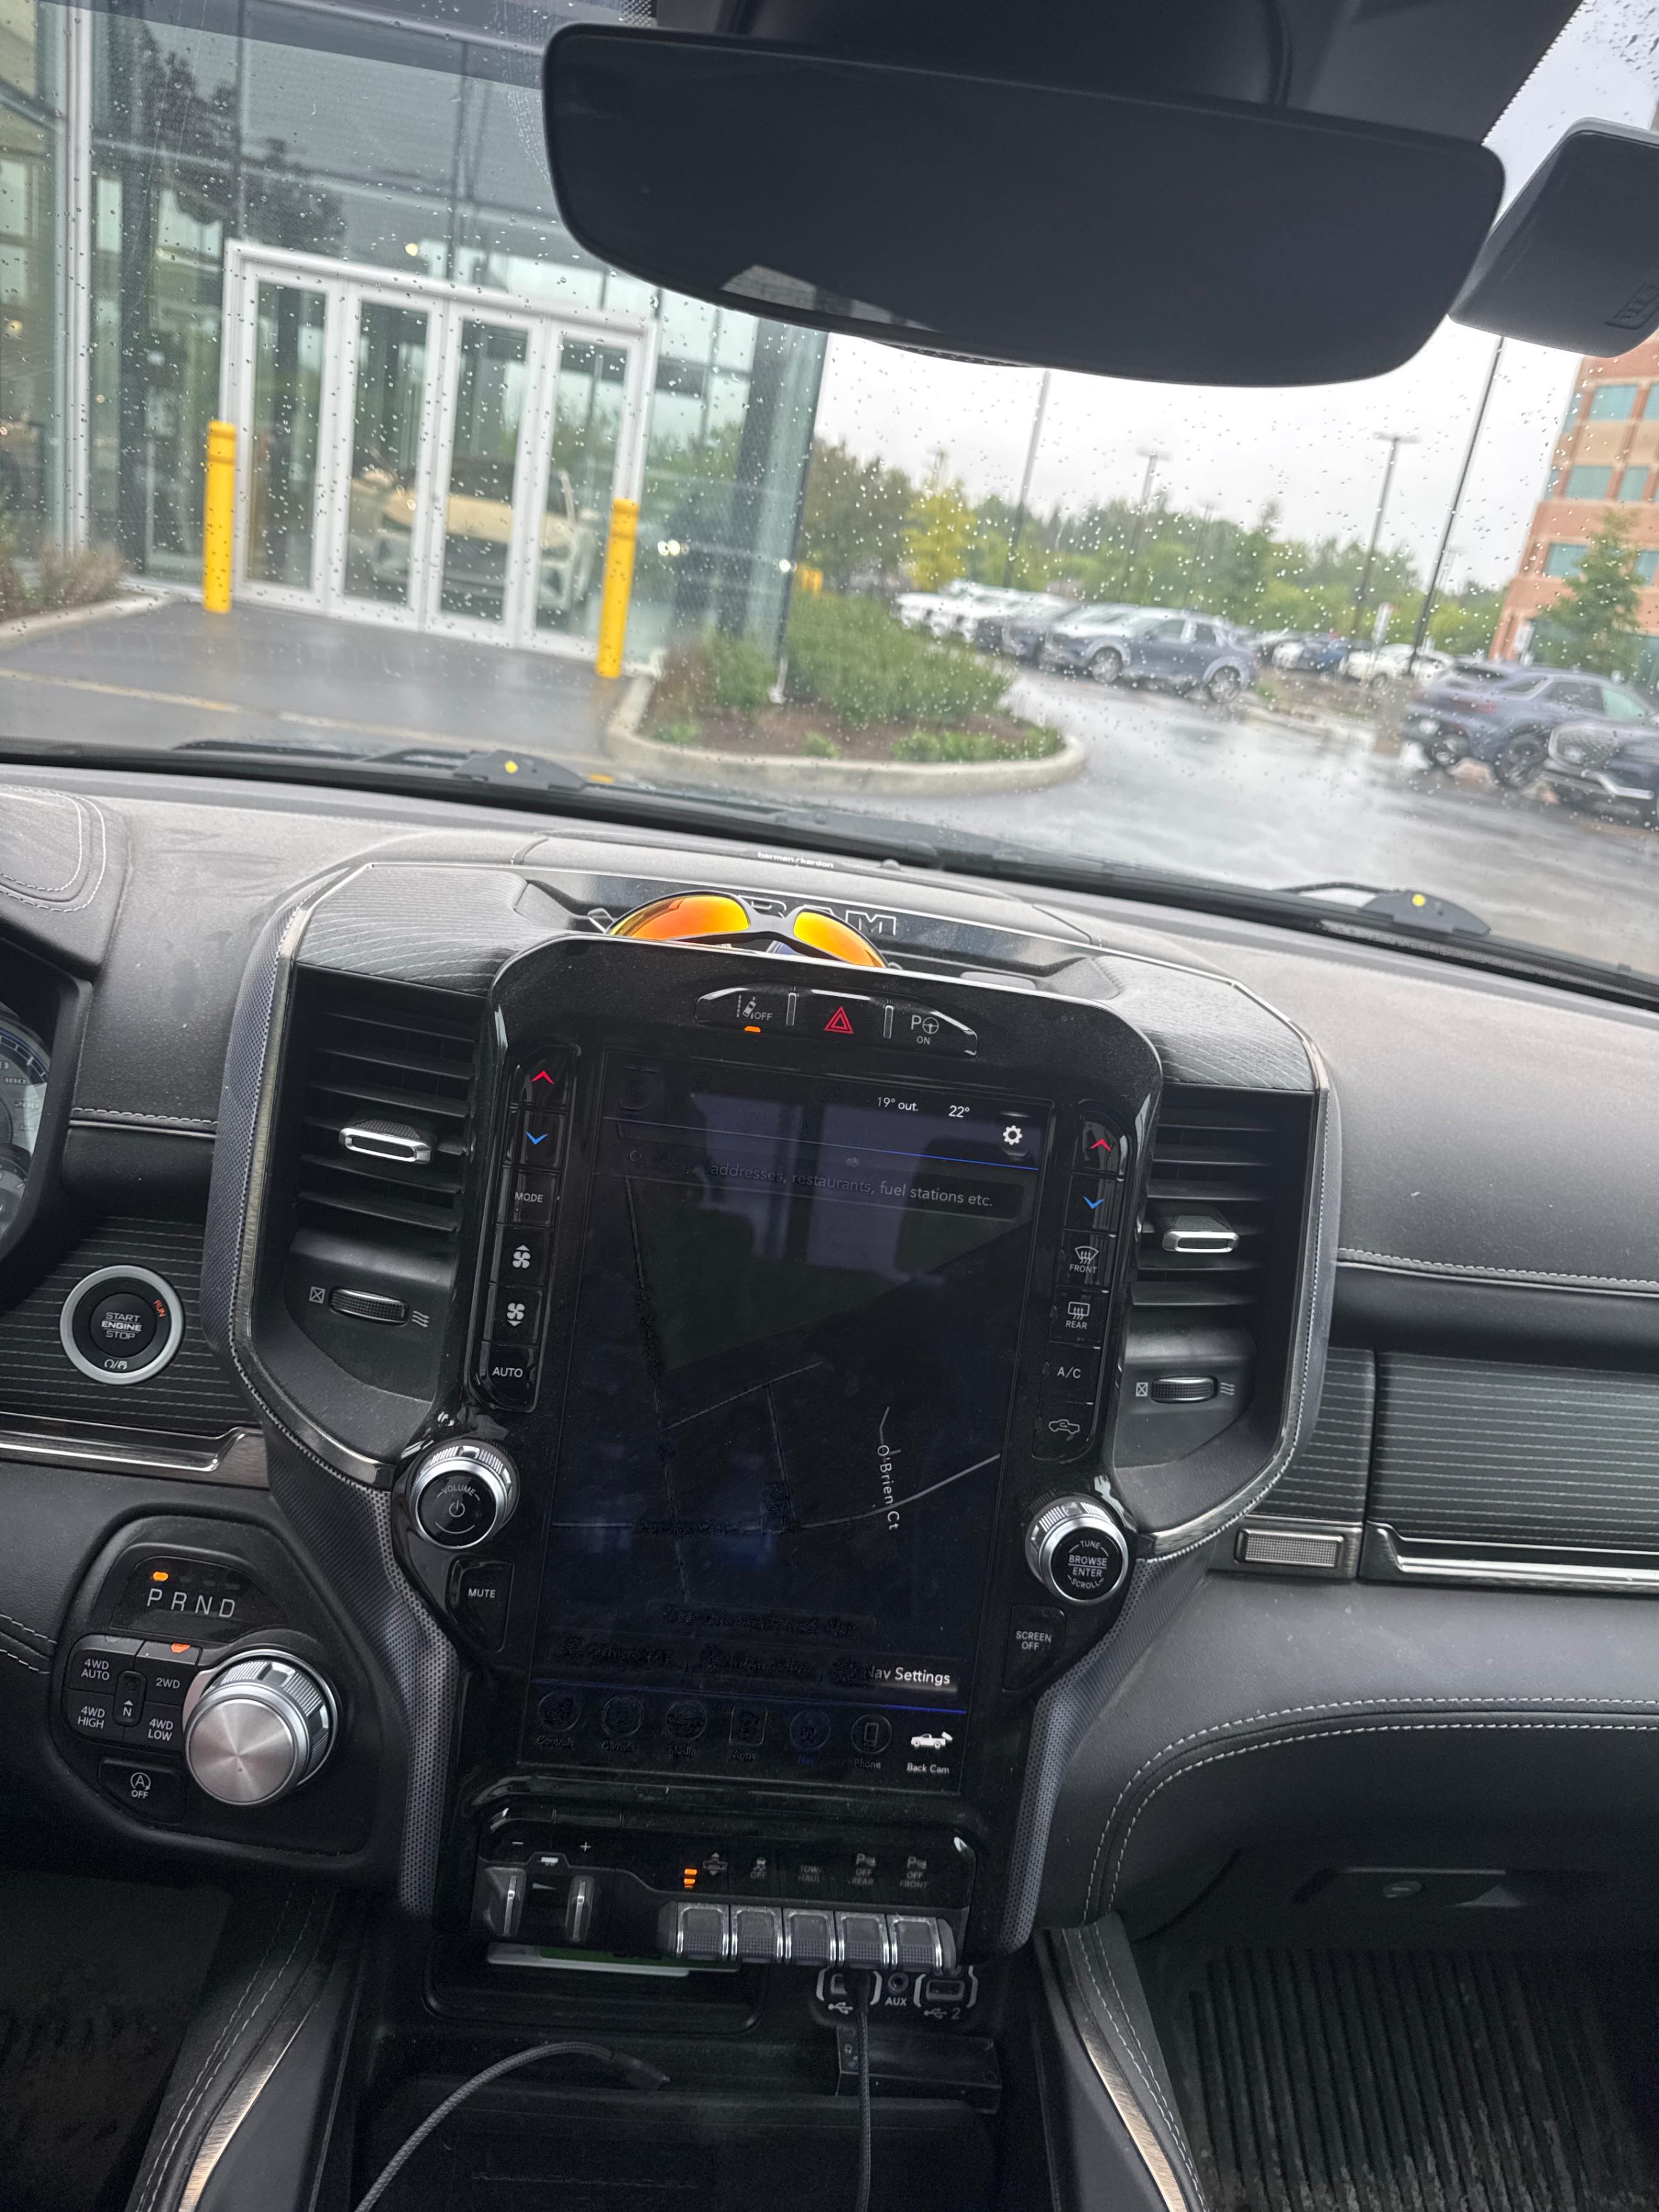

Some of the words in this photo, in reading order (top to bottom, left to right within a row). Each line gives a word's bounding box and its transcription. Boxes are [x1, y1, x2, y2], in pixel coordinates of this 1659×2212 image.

[757, 852, 834, 868] harman/kardon
[754, 1012, 772, 1021] OFF
[911, 1015, 921, 1031] P
[916, 1035, 930, 1045] ON
[876, 1096, 895, 1108] 19°
[898, 1100, 919, 1111] out.
[949, 1105, 970, 1118] 22°
[710, 1163, 788, 1184] addresses,
[792, 1172, 875, 1194] restaurants,
[879, 1180, 906, 1197] fuel
[910, 1184, 964, 1204] stations
[968, 1192, 993, 1207] etc.
[514, 1192, 543, 1203] MODE
[1069, 1264, 1098, 1274] FRONT
[153, 1299, 166, 1318] RUN
[106, 1312, 140, 1322] START
[102, 1321, 142, 1332] ENGINE
[1065, 1321, 1087, 1330] REAR
[106, 1330, 136, 1339] STOP
[492, 1367, 523, 1378] AUTO
[1057, 1366, 1081, 1379] A/C
[442, 1484, 476, 1496] VOLUME
[877, 1445, 895, 1504] O'Brien
[887, 1511, 899, 1530] Ct
[1080, 1540, 1101, 1550] TUNE
[1068, 1554, 1107, 1567] BROWSE
[1072, 1567, 1103, 1578] ENTER
[1071, 1578, 1100, 1589] SCROLL
[468, 1588, 496, 1598] MUTE
[147, 1588, 162, 1607] P
[171, 1592, 187, 1611] R
[195, 1595, 213, 1615] N
[219, 1599, 235, 1618] D
[1016, 1631, 1051, 1643] SCREEN
[1022, 1641, 1039, 1650] OFF
[85, 1658, 109, 1670] 4WD
[81, 1668, 110, 1681] AUTO
[895, 1667, 951, 1686] Settings
[156, 1678, 181, 1689] 2WD
[81, 1706, 105, 1718] 4WD
[123, 1707, 132, 1717] N
[77, 1716, 105, 1729] HIGH
[149, 1718, 173, 1730] 4WD
[148, 1729, 172, 1741] LOW
[907, 1762, 927, 1773] Back
[929, 1763, 950, 1774] Cam
[131, 1789, 149, 1799] OFF
[750, 1871, 767, 1879] OFF
[856, 1868, 873, 1876] OFF
[907, 1871, 923, 1879] OFF
[798, 1873, 822, 1883] HAUL
[852, 1877, 874, 1886] REAR
[899, 1879, 928, 1889] FRONT
[885, 1996, 907, 2006] AUX
[951, 2007, 961, 2020] 2
